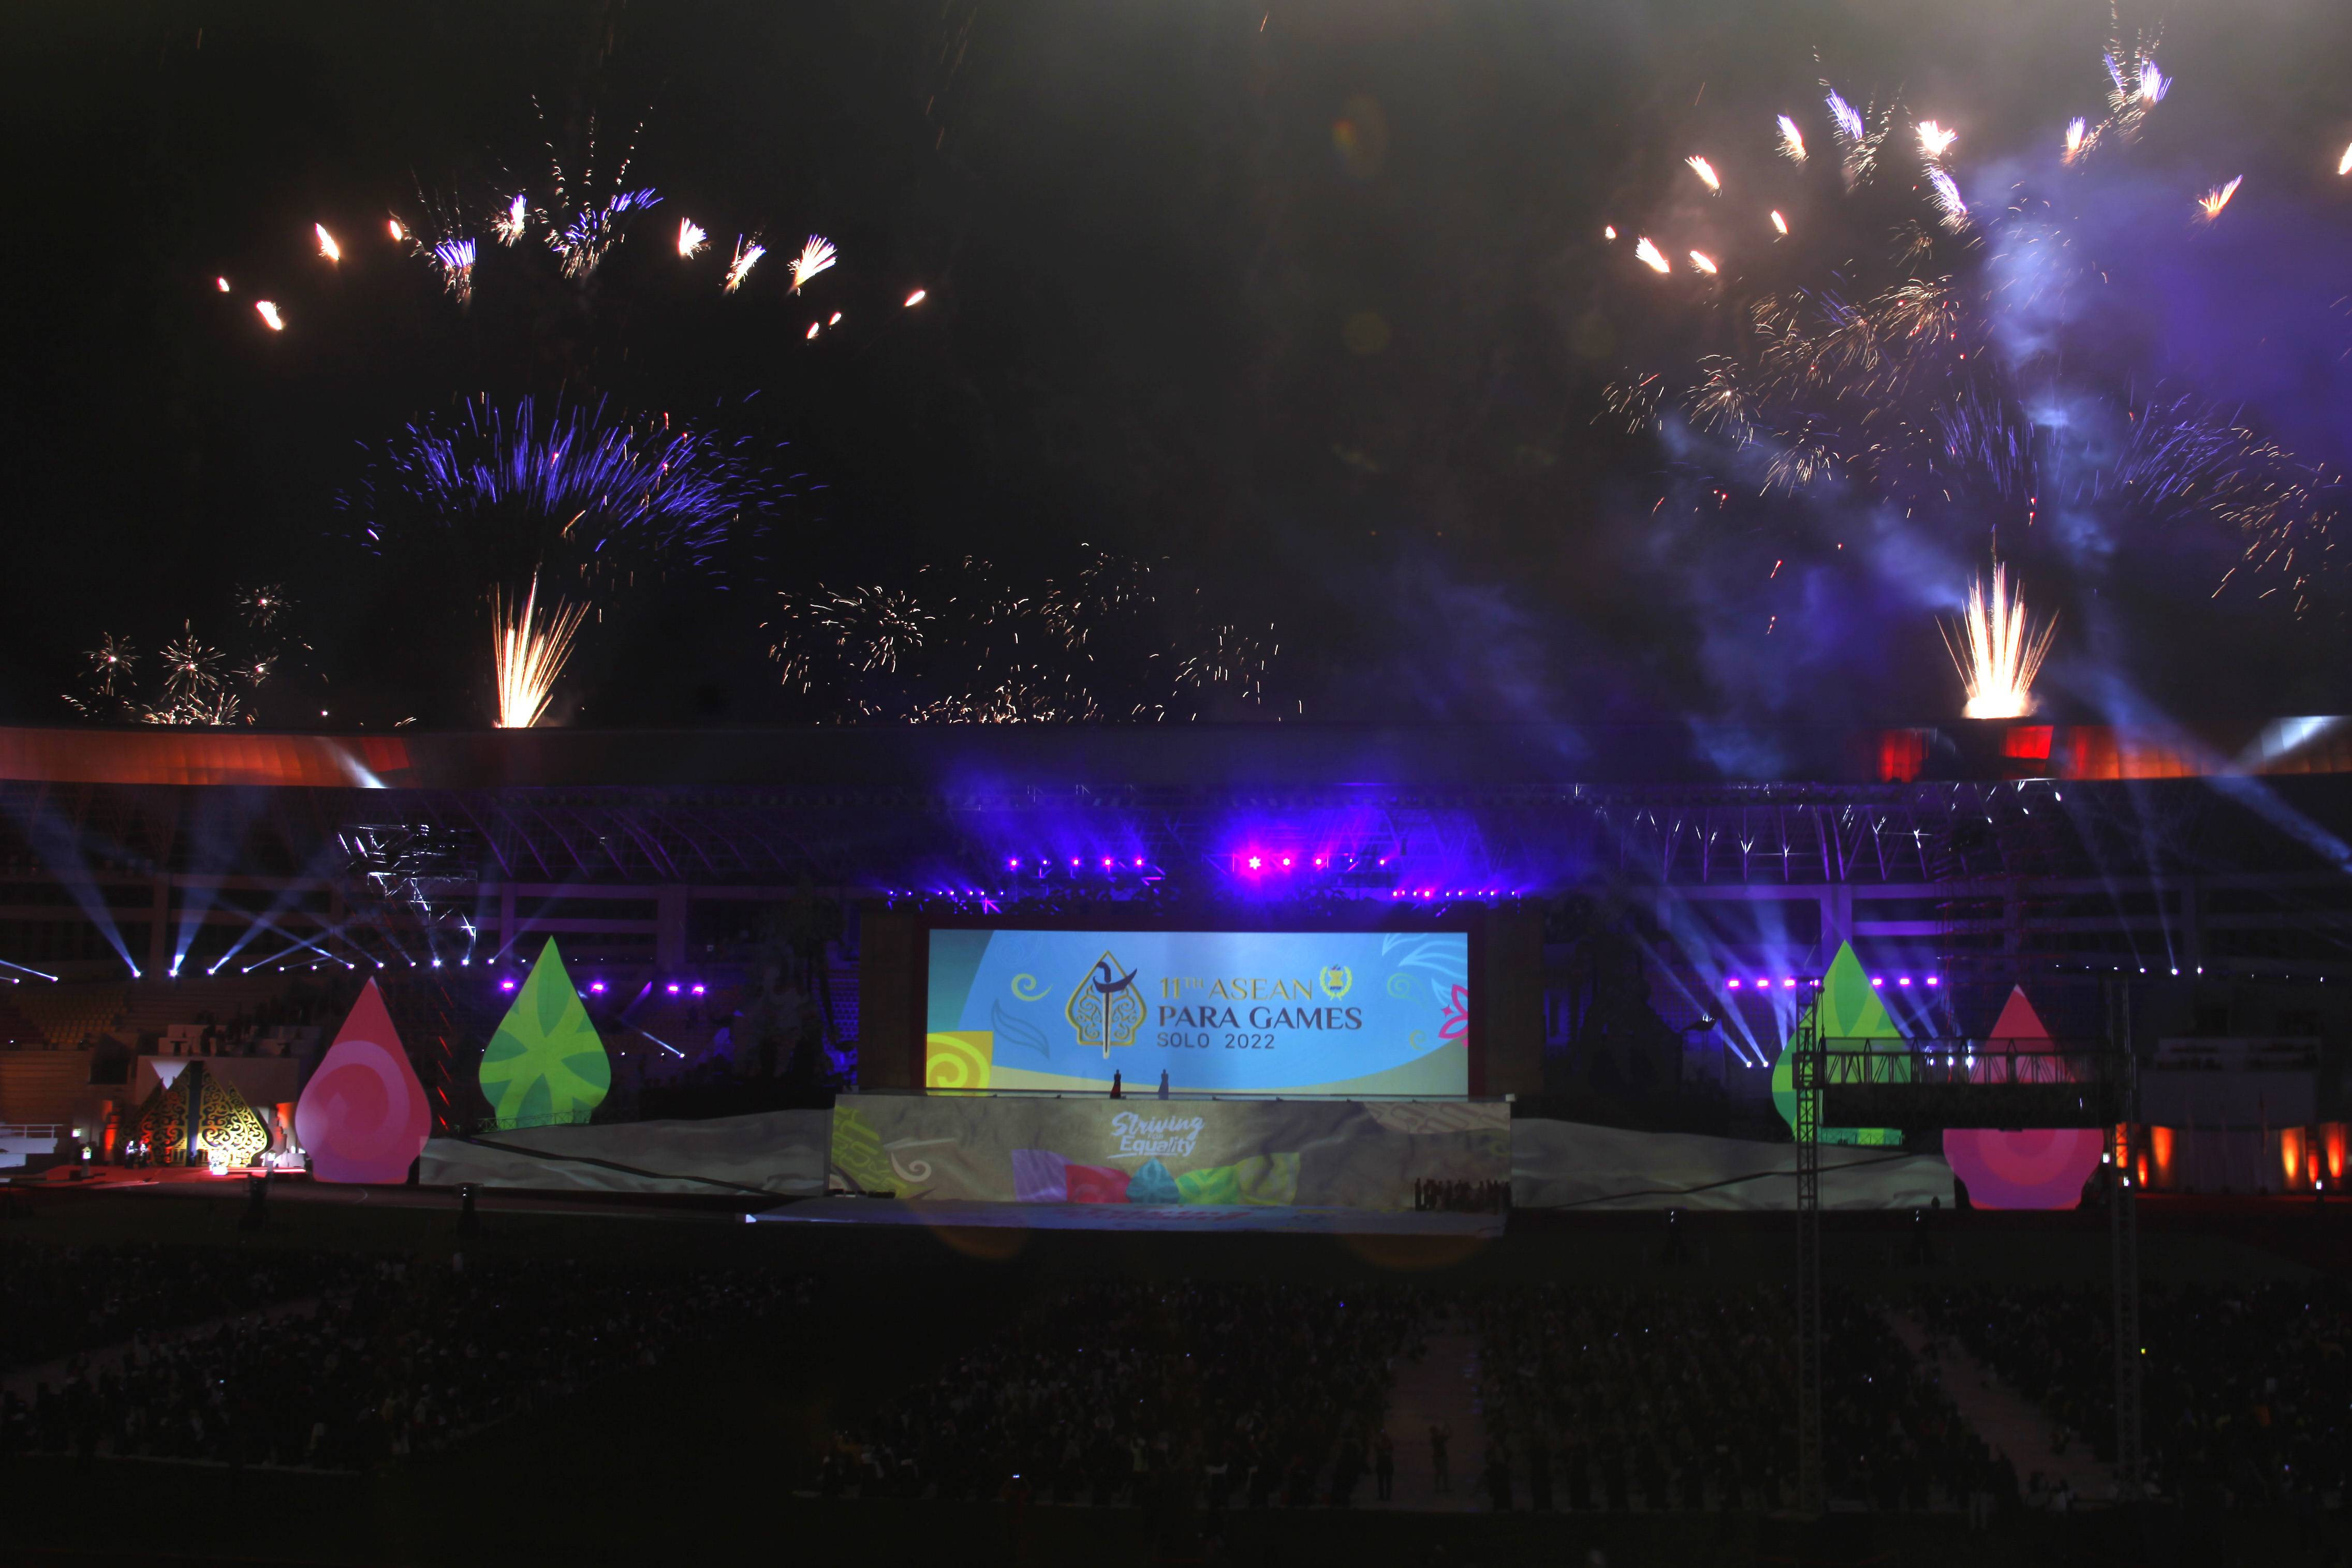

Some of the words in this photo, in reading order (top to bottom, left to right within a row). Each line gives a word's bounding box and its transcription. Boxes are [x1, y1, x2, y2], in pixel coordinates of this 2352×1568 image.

[1159, 977, 1203, 999] 11TH
[1208, 978, 1312, 1000] ASEAN
[1157, 1005, 1241, 1028] PARA
[1249, 1006, 1362, 1030] GAMES
[1157, 1032, 1210, 1048] SOLO
[1225, 1033, 1275, 1049] 2022
[1110, 1111, 1205, 1141] Striving
[1120, 1135, 1197, 1157] Equality
